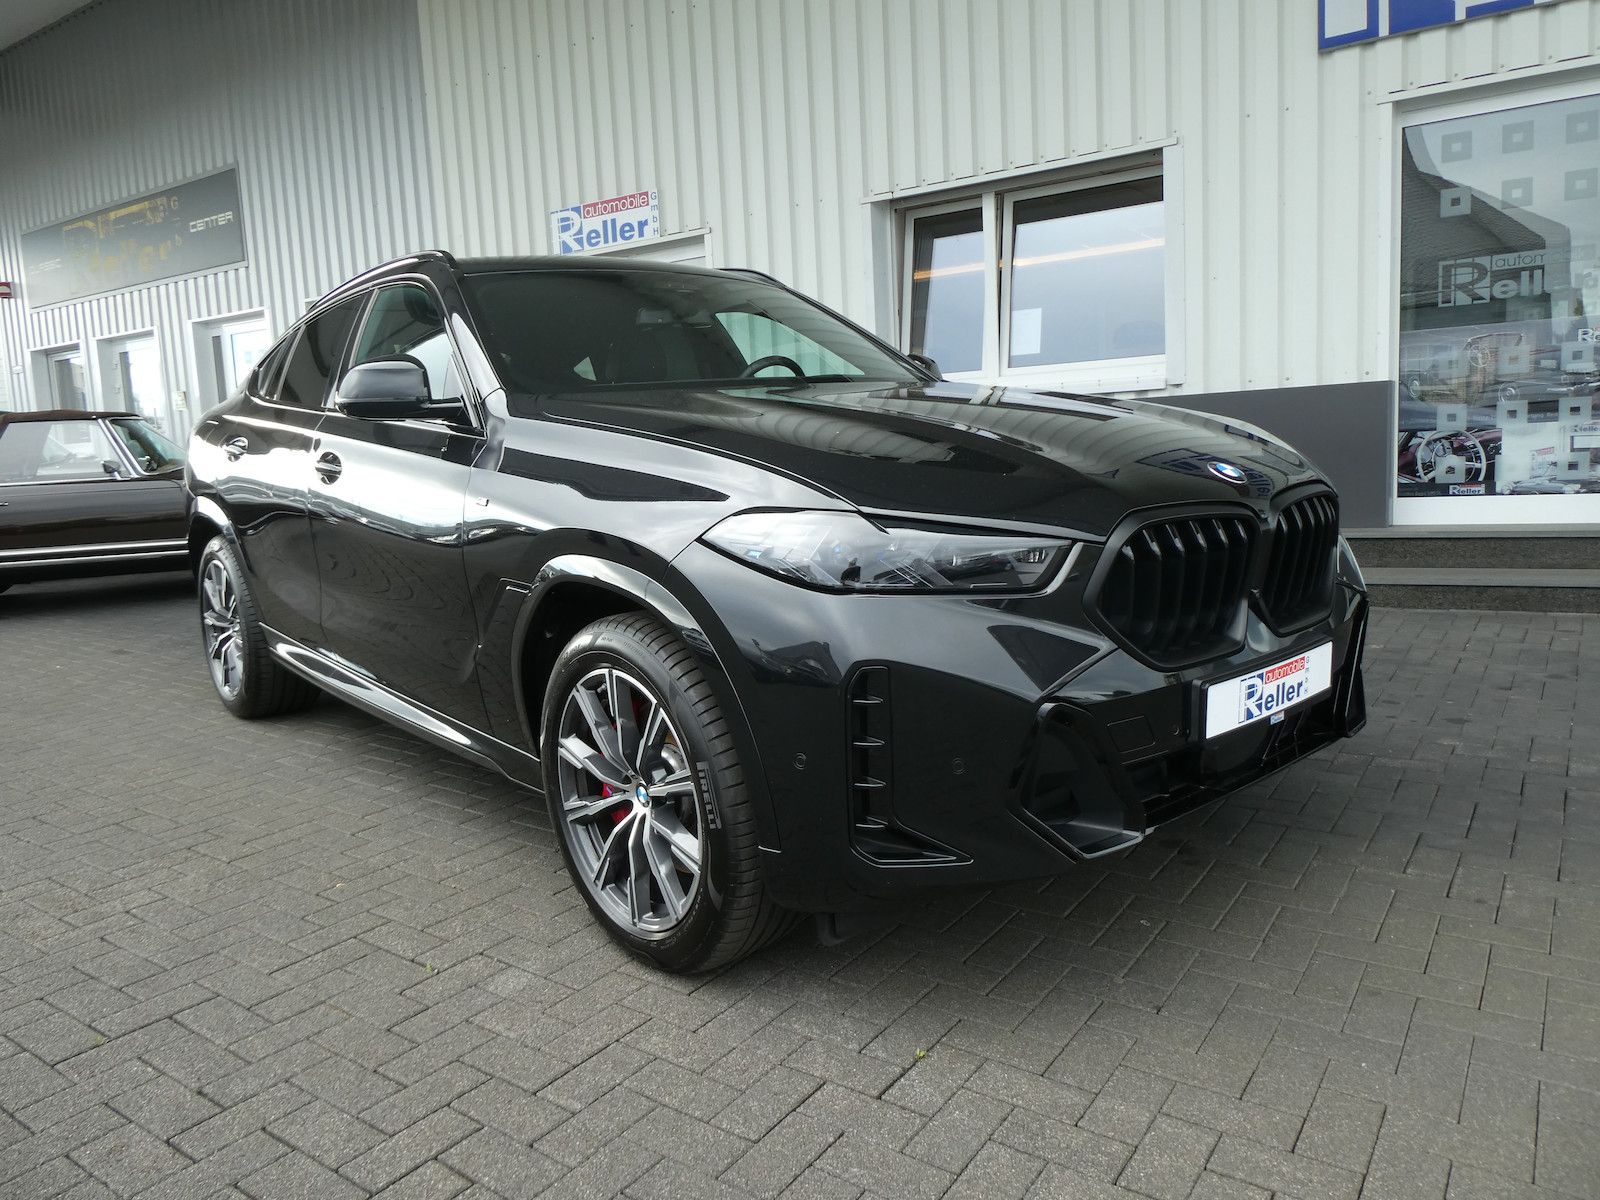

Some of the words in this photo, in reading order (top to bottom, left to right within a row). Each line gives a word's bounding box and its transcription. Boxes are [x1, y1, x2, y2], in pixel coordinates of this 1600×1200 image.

[583, 193, 648, 218] automobile
[188, 210, 234, 233] CENTER
[551, 208, 648, 255] Reller
[1265, 658, 1305, 684] automobile
[1238, 673, 1303, 724] Reller
